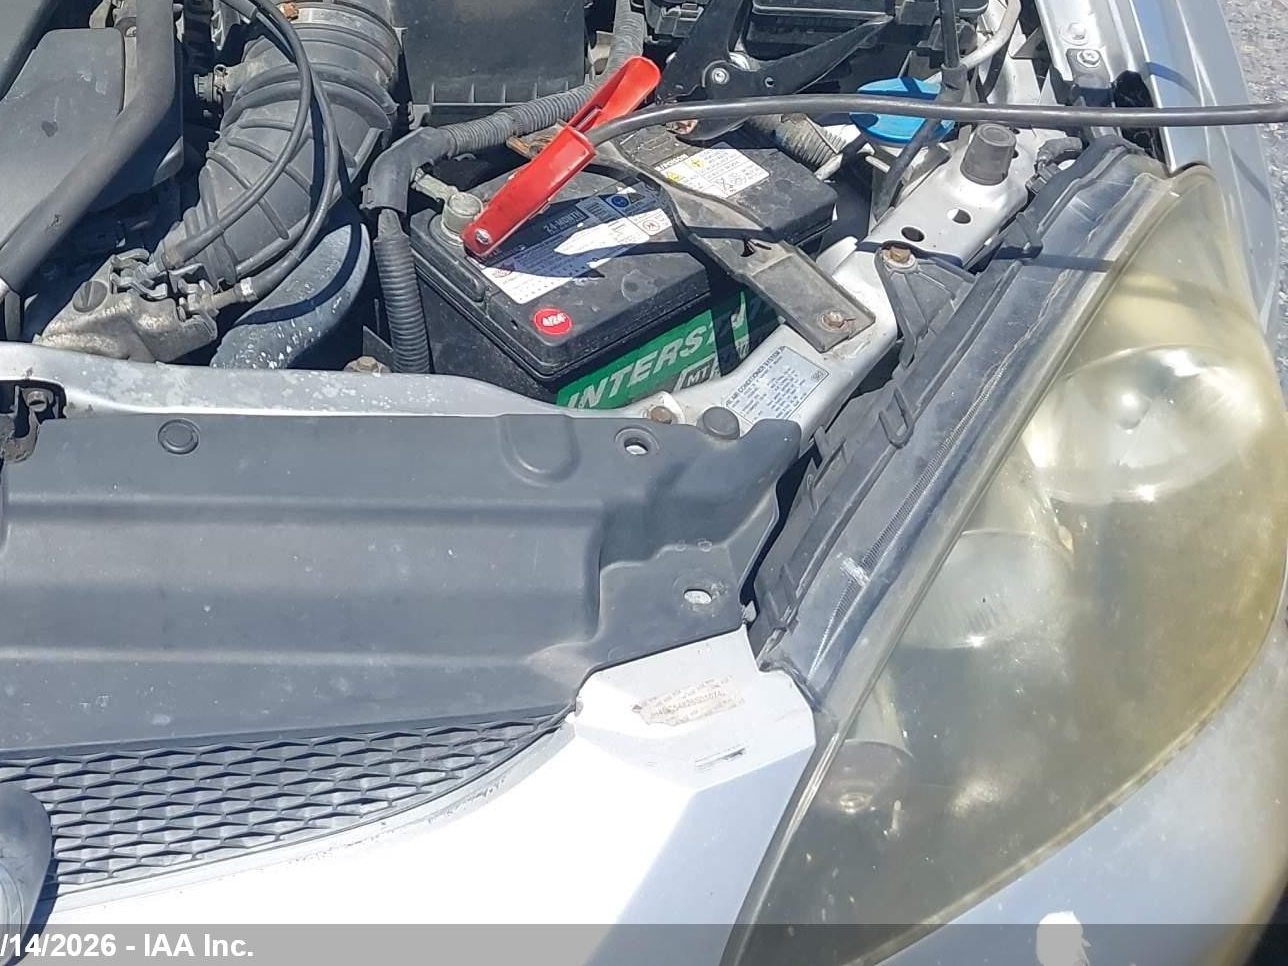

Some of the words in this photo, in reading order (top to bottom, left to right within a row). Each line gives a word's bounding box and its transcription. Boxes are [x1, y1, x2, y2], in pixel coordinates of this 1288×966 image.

[567, 320, 715, 410] INTERS
[737, 363, 767, 393] CONDITIONER
[763, 348, 781, 367] SYSTEM
